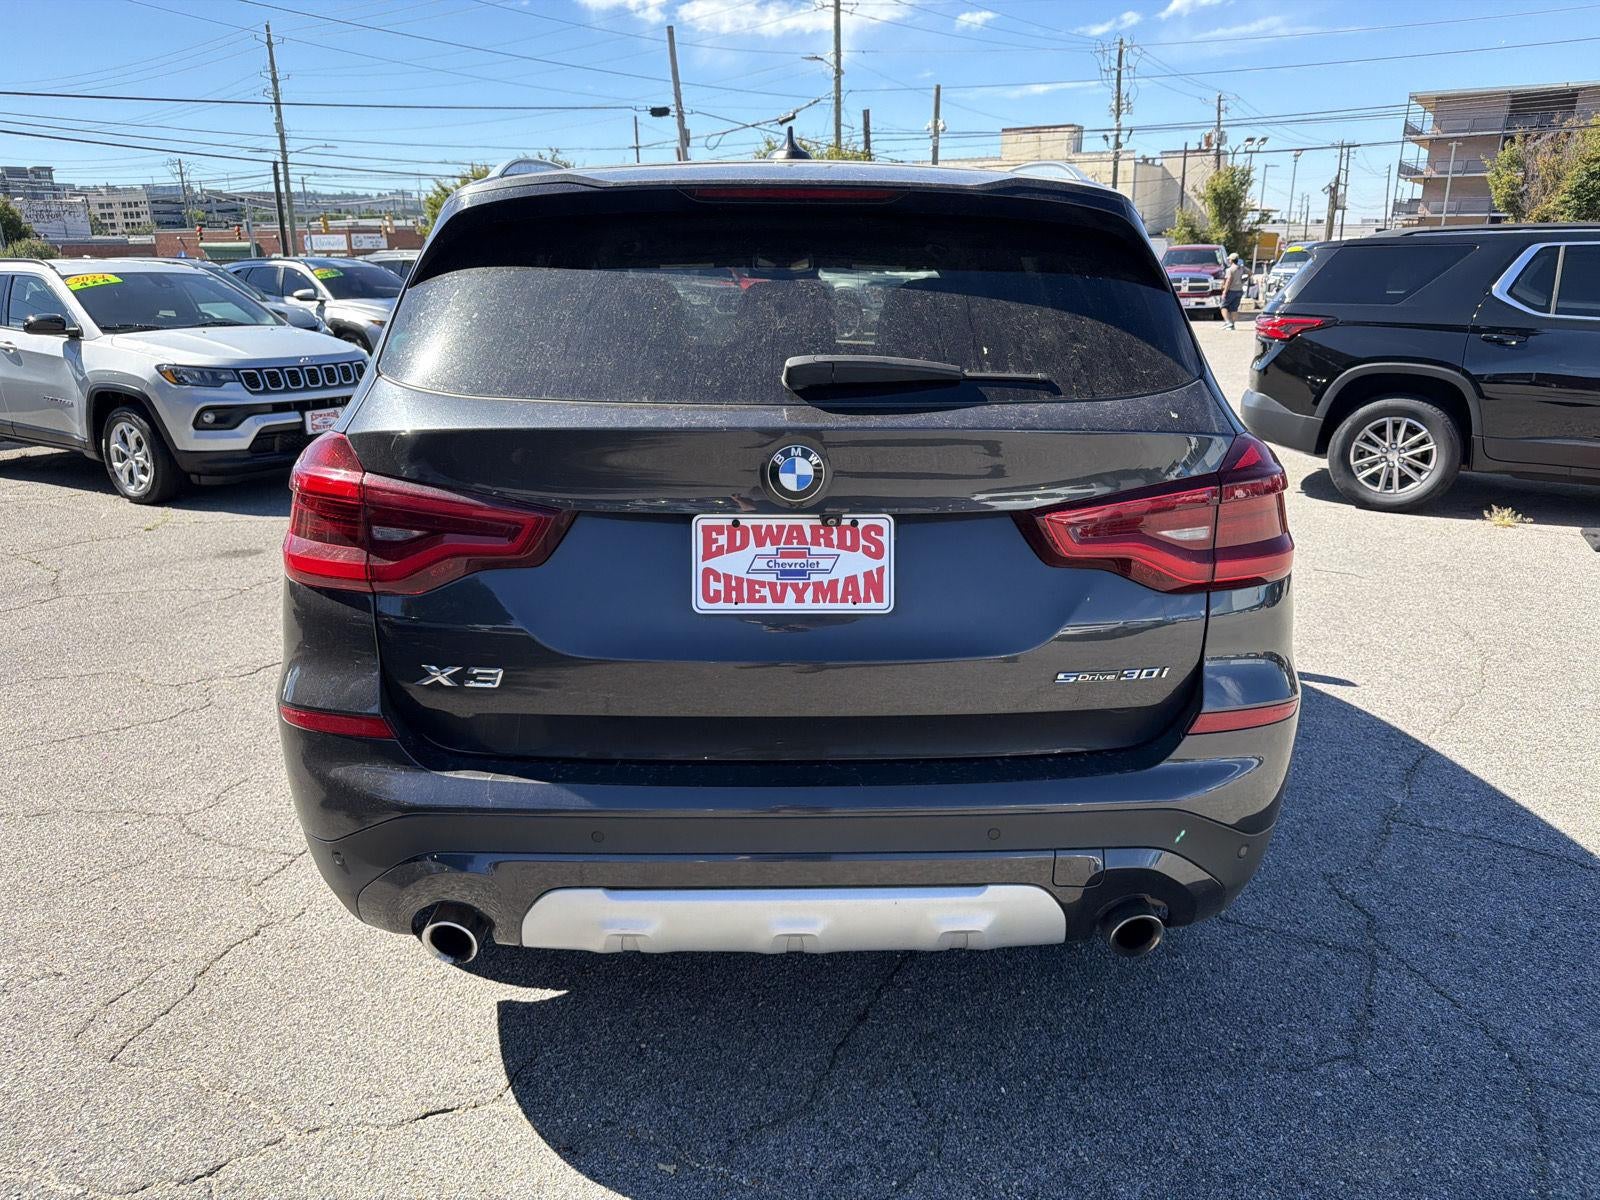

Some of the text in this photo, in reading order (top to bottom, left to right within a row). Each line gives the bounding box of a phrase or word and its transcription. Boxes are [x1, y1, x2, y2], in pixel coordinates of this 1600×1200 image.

[774, 447, 820, 466] BMW
[701, 523, 886, 562] EDWARDS
[766, 559, 821, 570] Chevrolet
[701, 565, 886, 604] CHEVYMAN
[414, 664, 504, 688] X3
